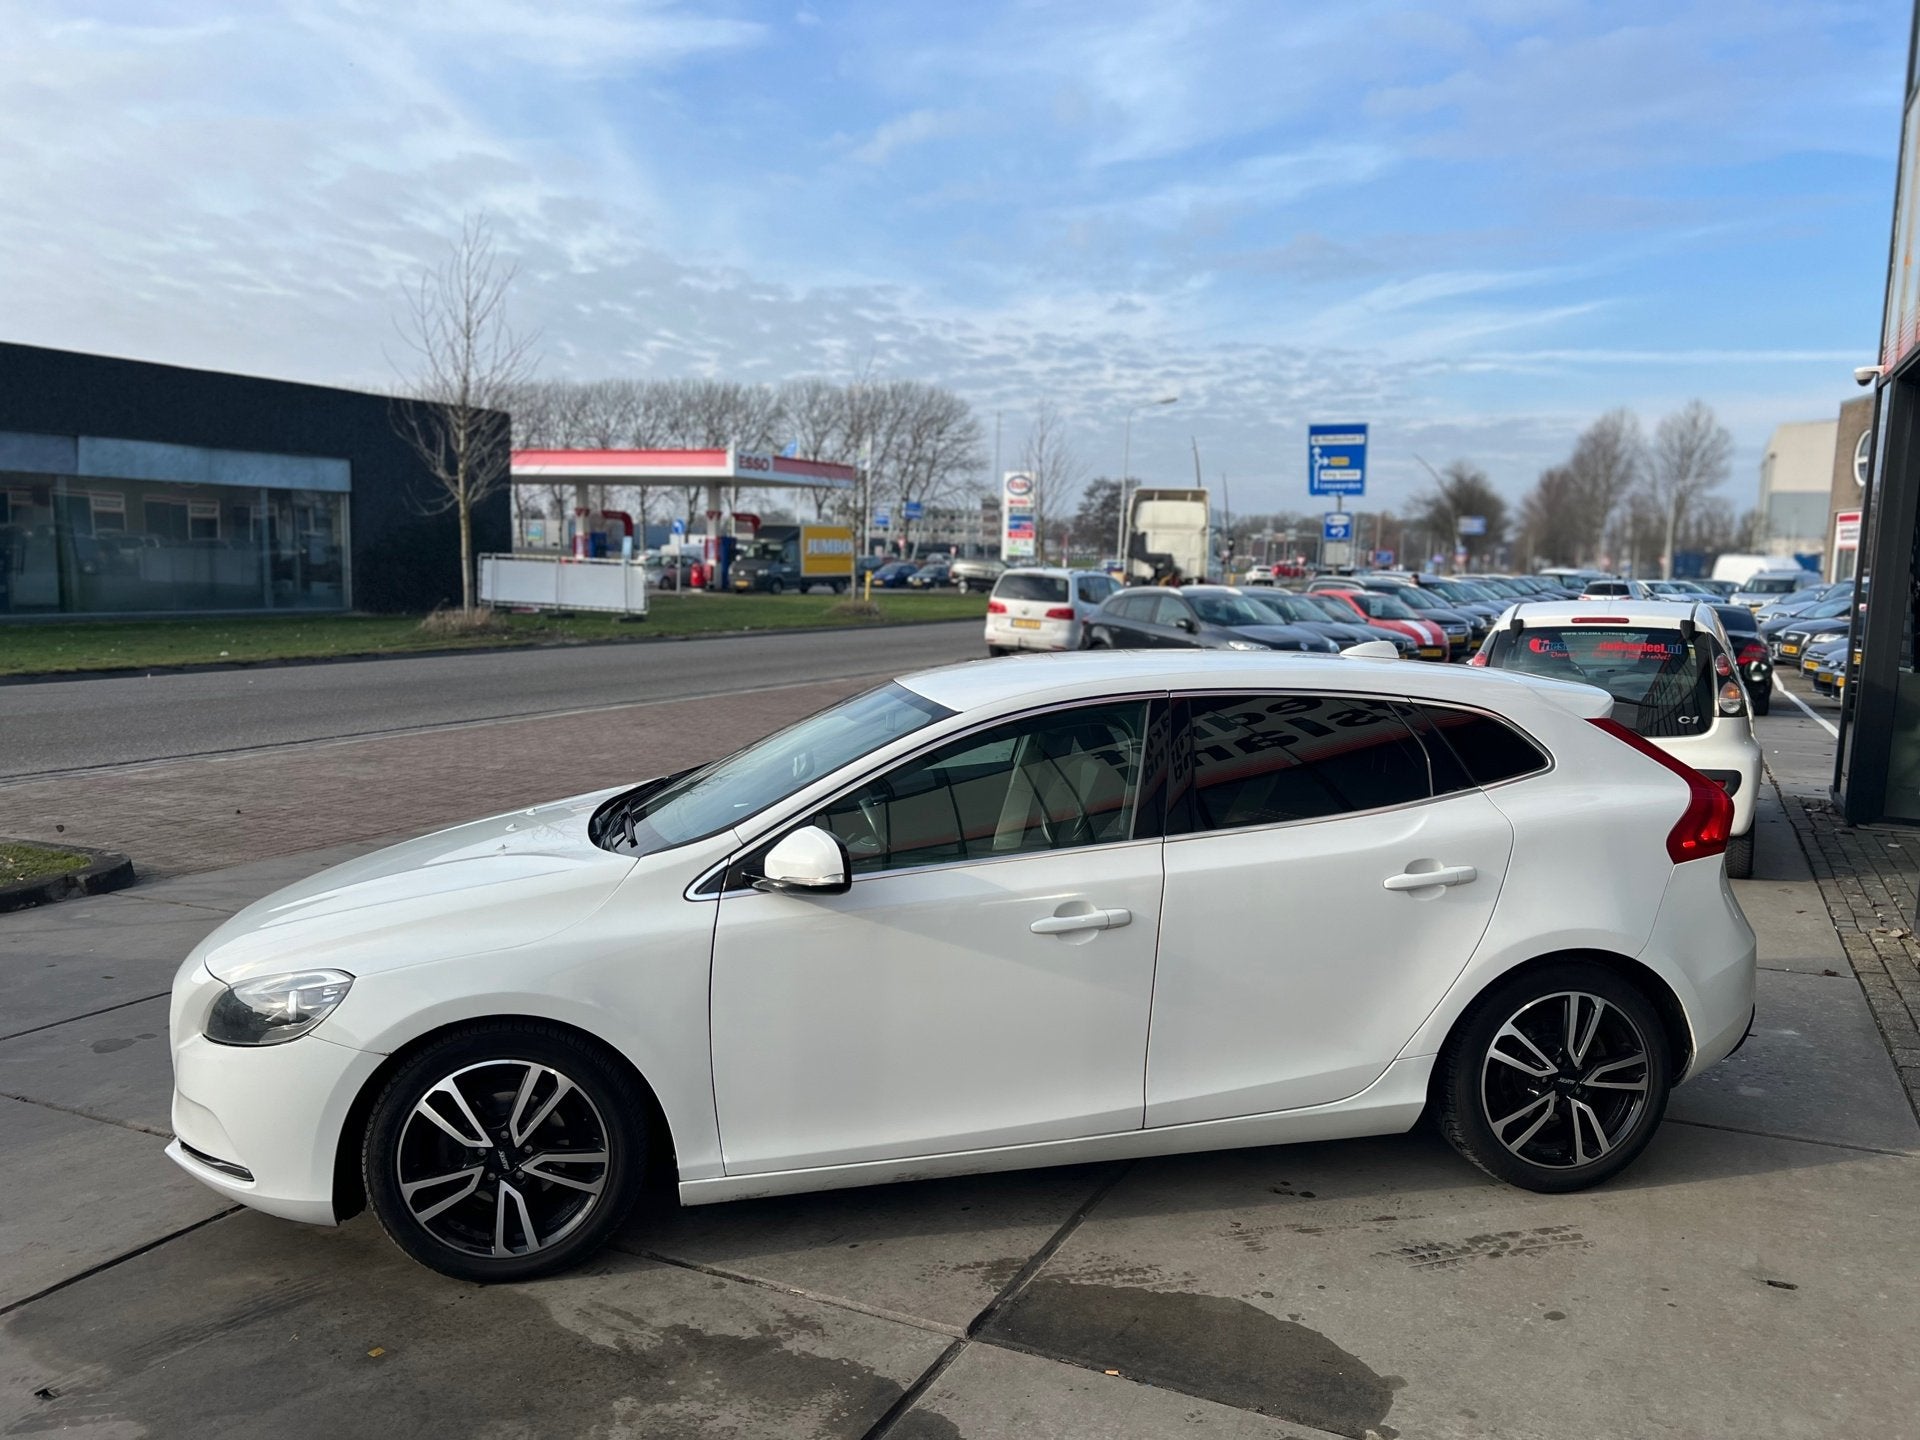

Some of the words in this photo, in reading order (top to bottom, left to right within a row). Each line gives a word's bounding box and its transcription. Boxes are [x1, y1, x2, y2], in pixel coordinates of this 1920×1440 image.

[739, 455, 769, 471] ESSO
[808, 539, 852, 554] JUMBO
[1678, 715, 1699, 724] C1
